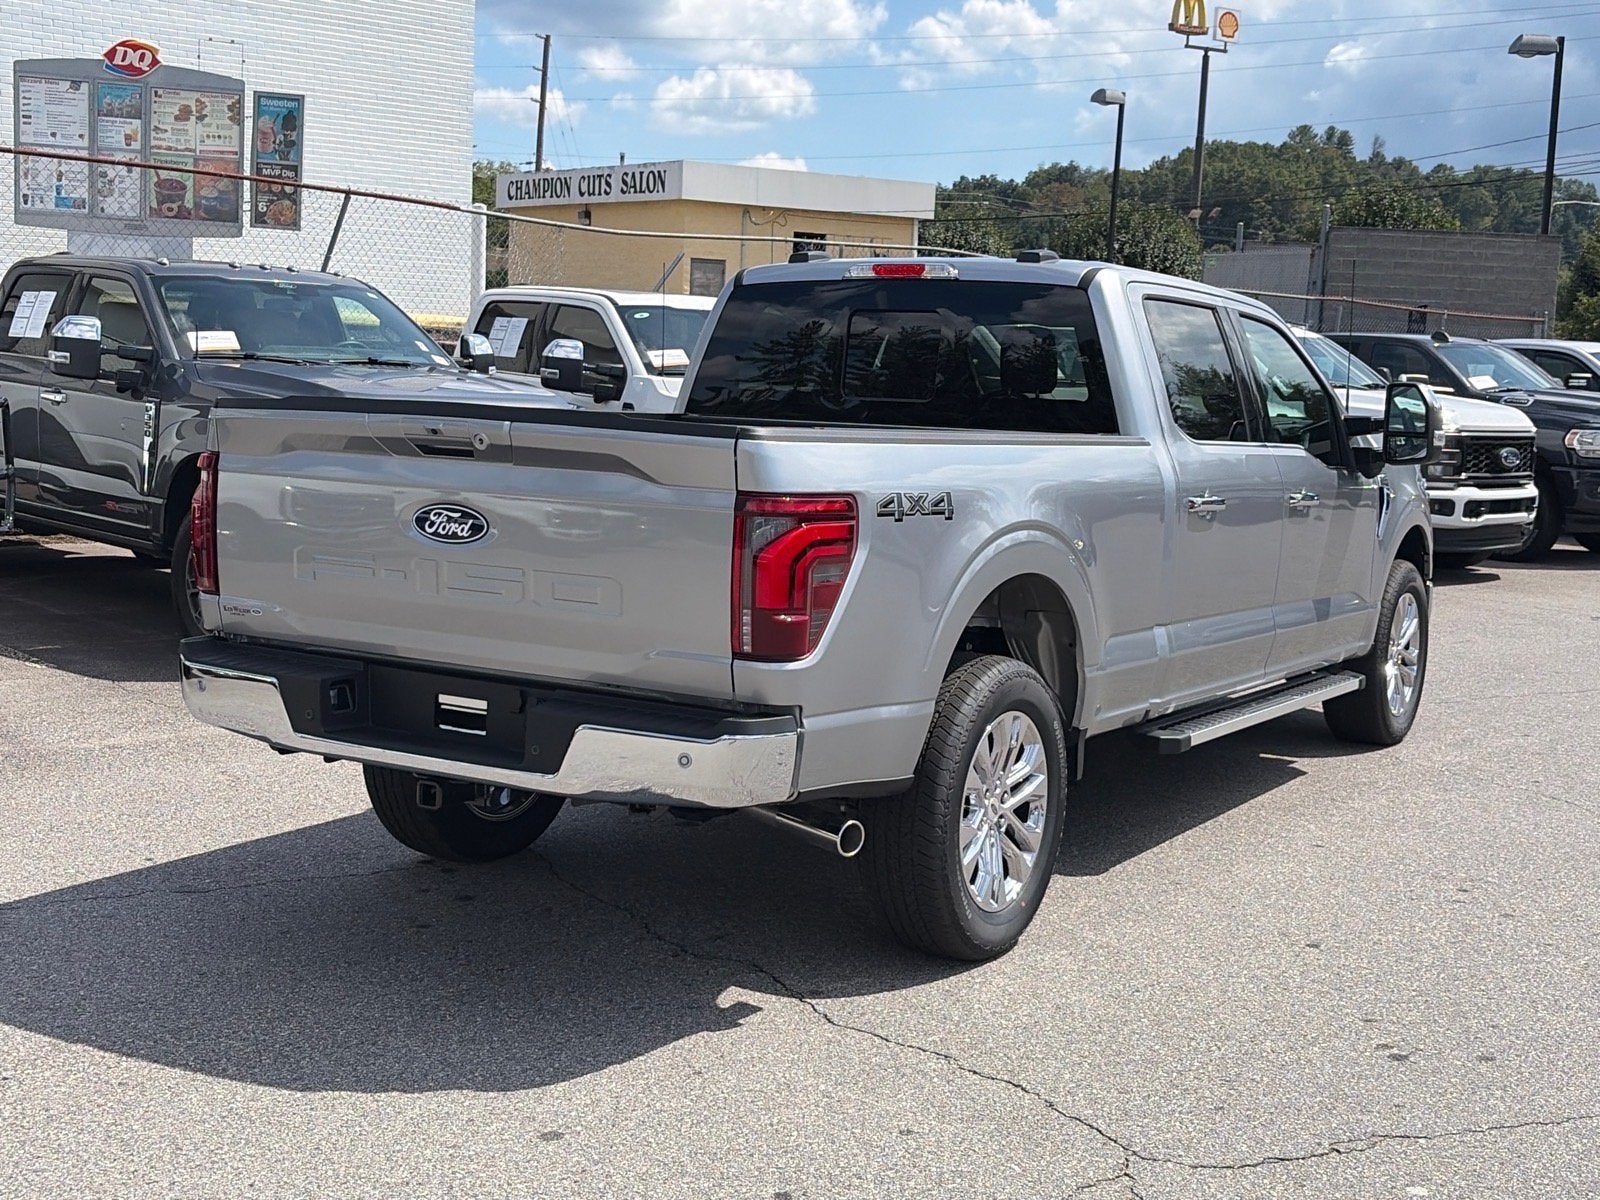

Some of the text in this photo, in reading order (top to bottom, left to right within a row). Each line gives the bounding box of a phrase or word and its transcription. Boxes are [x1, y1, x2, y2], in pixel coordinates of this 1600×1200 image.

[112, 46, 152, 71] DQ
[260, 97, 298, 109] Sweeten
[262, 168, 281, 176] MVP
[507, 170, 667, 201] CHAMPION CUTS SALON
[424, 509, 472, 538] Ford
